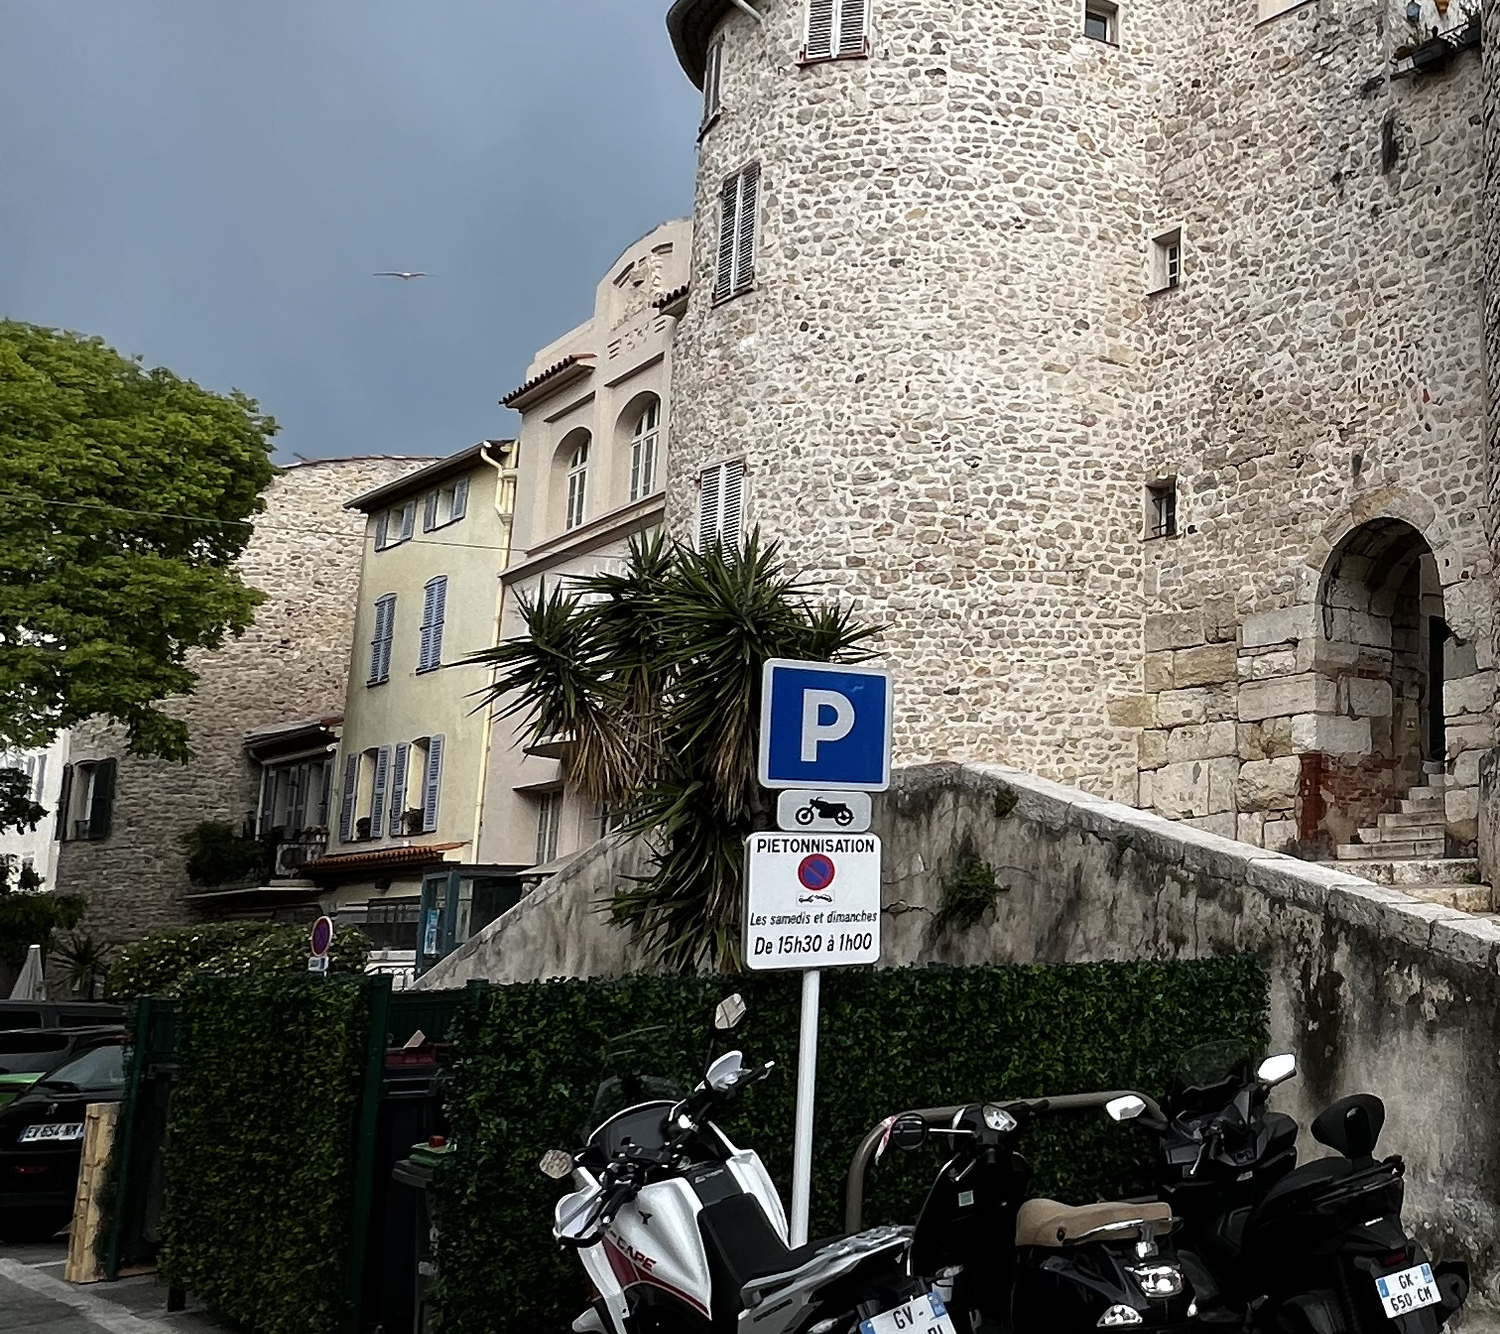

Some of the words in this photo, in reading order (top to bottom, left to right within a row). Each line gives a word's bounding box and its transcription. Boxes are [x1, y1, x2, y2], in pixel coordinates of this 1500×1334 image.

[800, 689, 855, 762] P
[757, 839, 875, 853] PIETONNISATION
[750, 912, 767, 926] Les
[770, 911, 811, 925] samedis
[813, 912, 824, 924] et
[827, 909, 877, 922] dimanches
[754, 937, 773, 955] De
[778, 934, 822, 954] 15h30
[827, 934, 835, 951] à
[839, 932, 872, 951] 1h00
